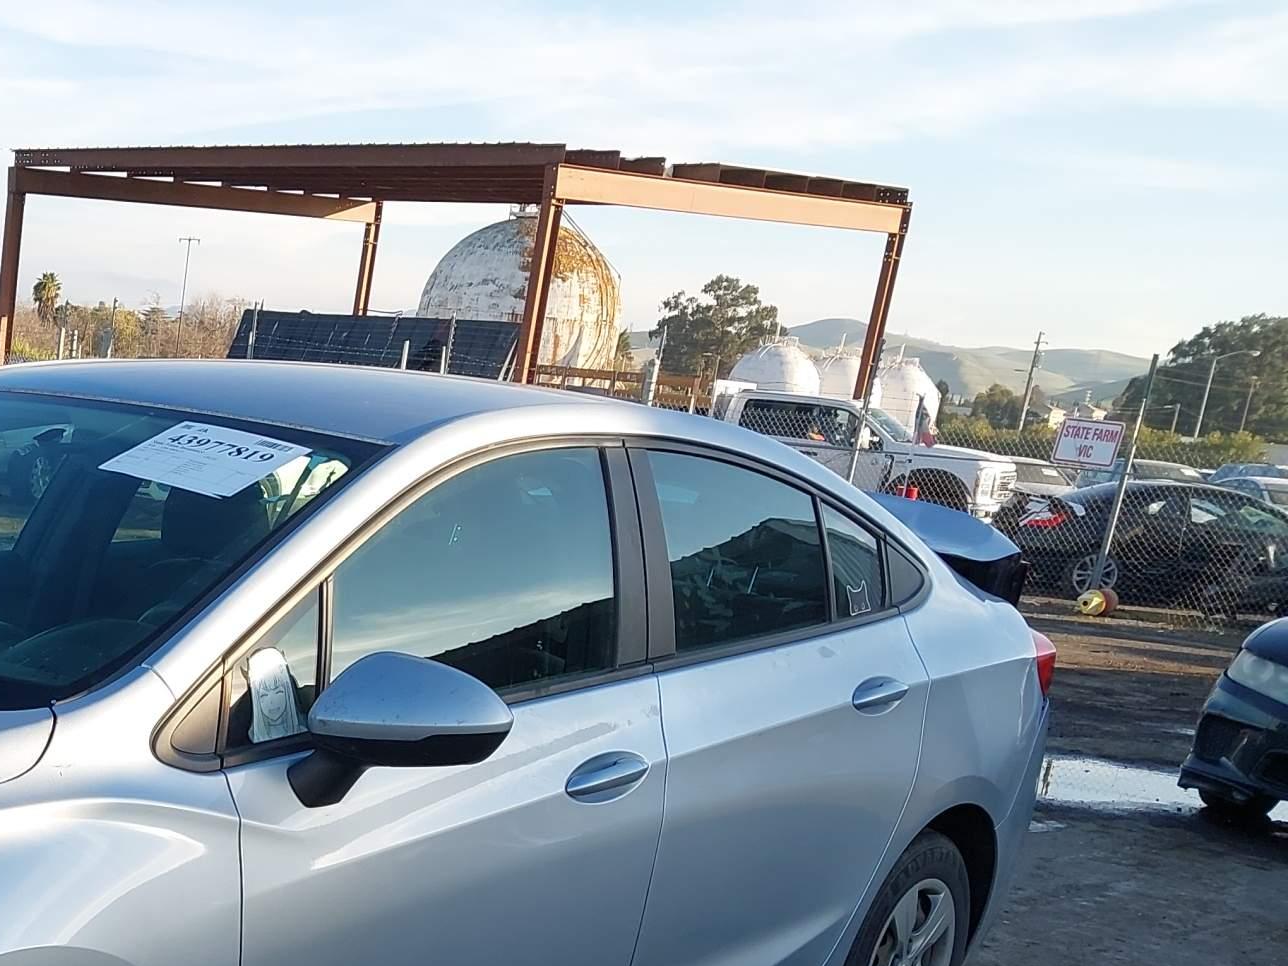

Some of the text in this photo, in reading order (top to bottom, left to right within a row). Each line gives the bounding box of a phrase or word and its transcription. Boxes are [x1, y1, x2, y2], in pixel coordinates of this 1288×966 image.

[1064, 425, 1119, 443] STATE FARM
[168, 433, 275, 463] 43977819
[1078, 444, 1094, 458] VIC
